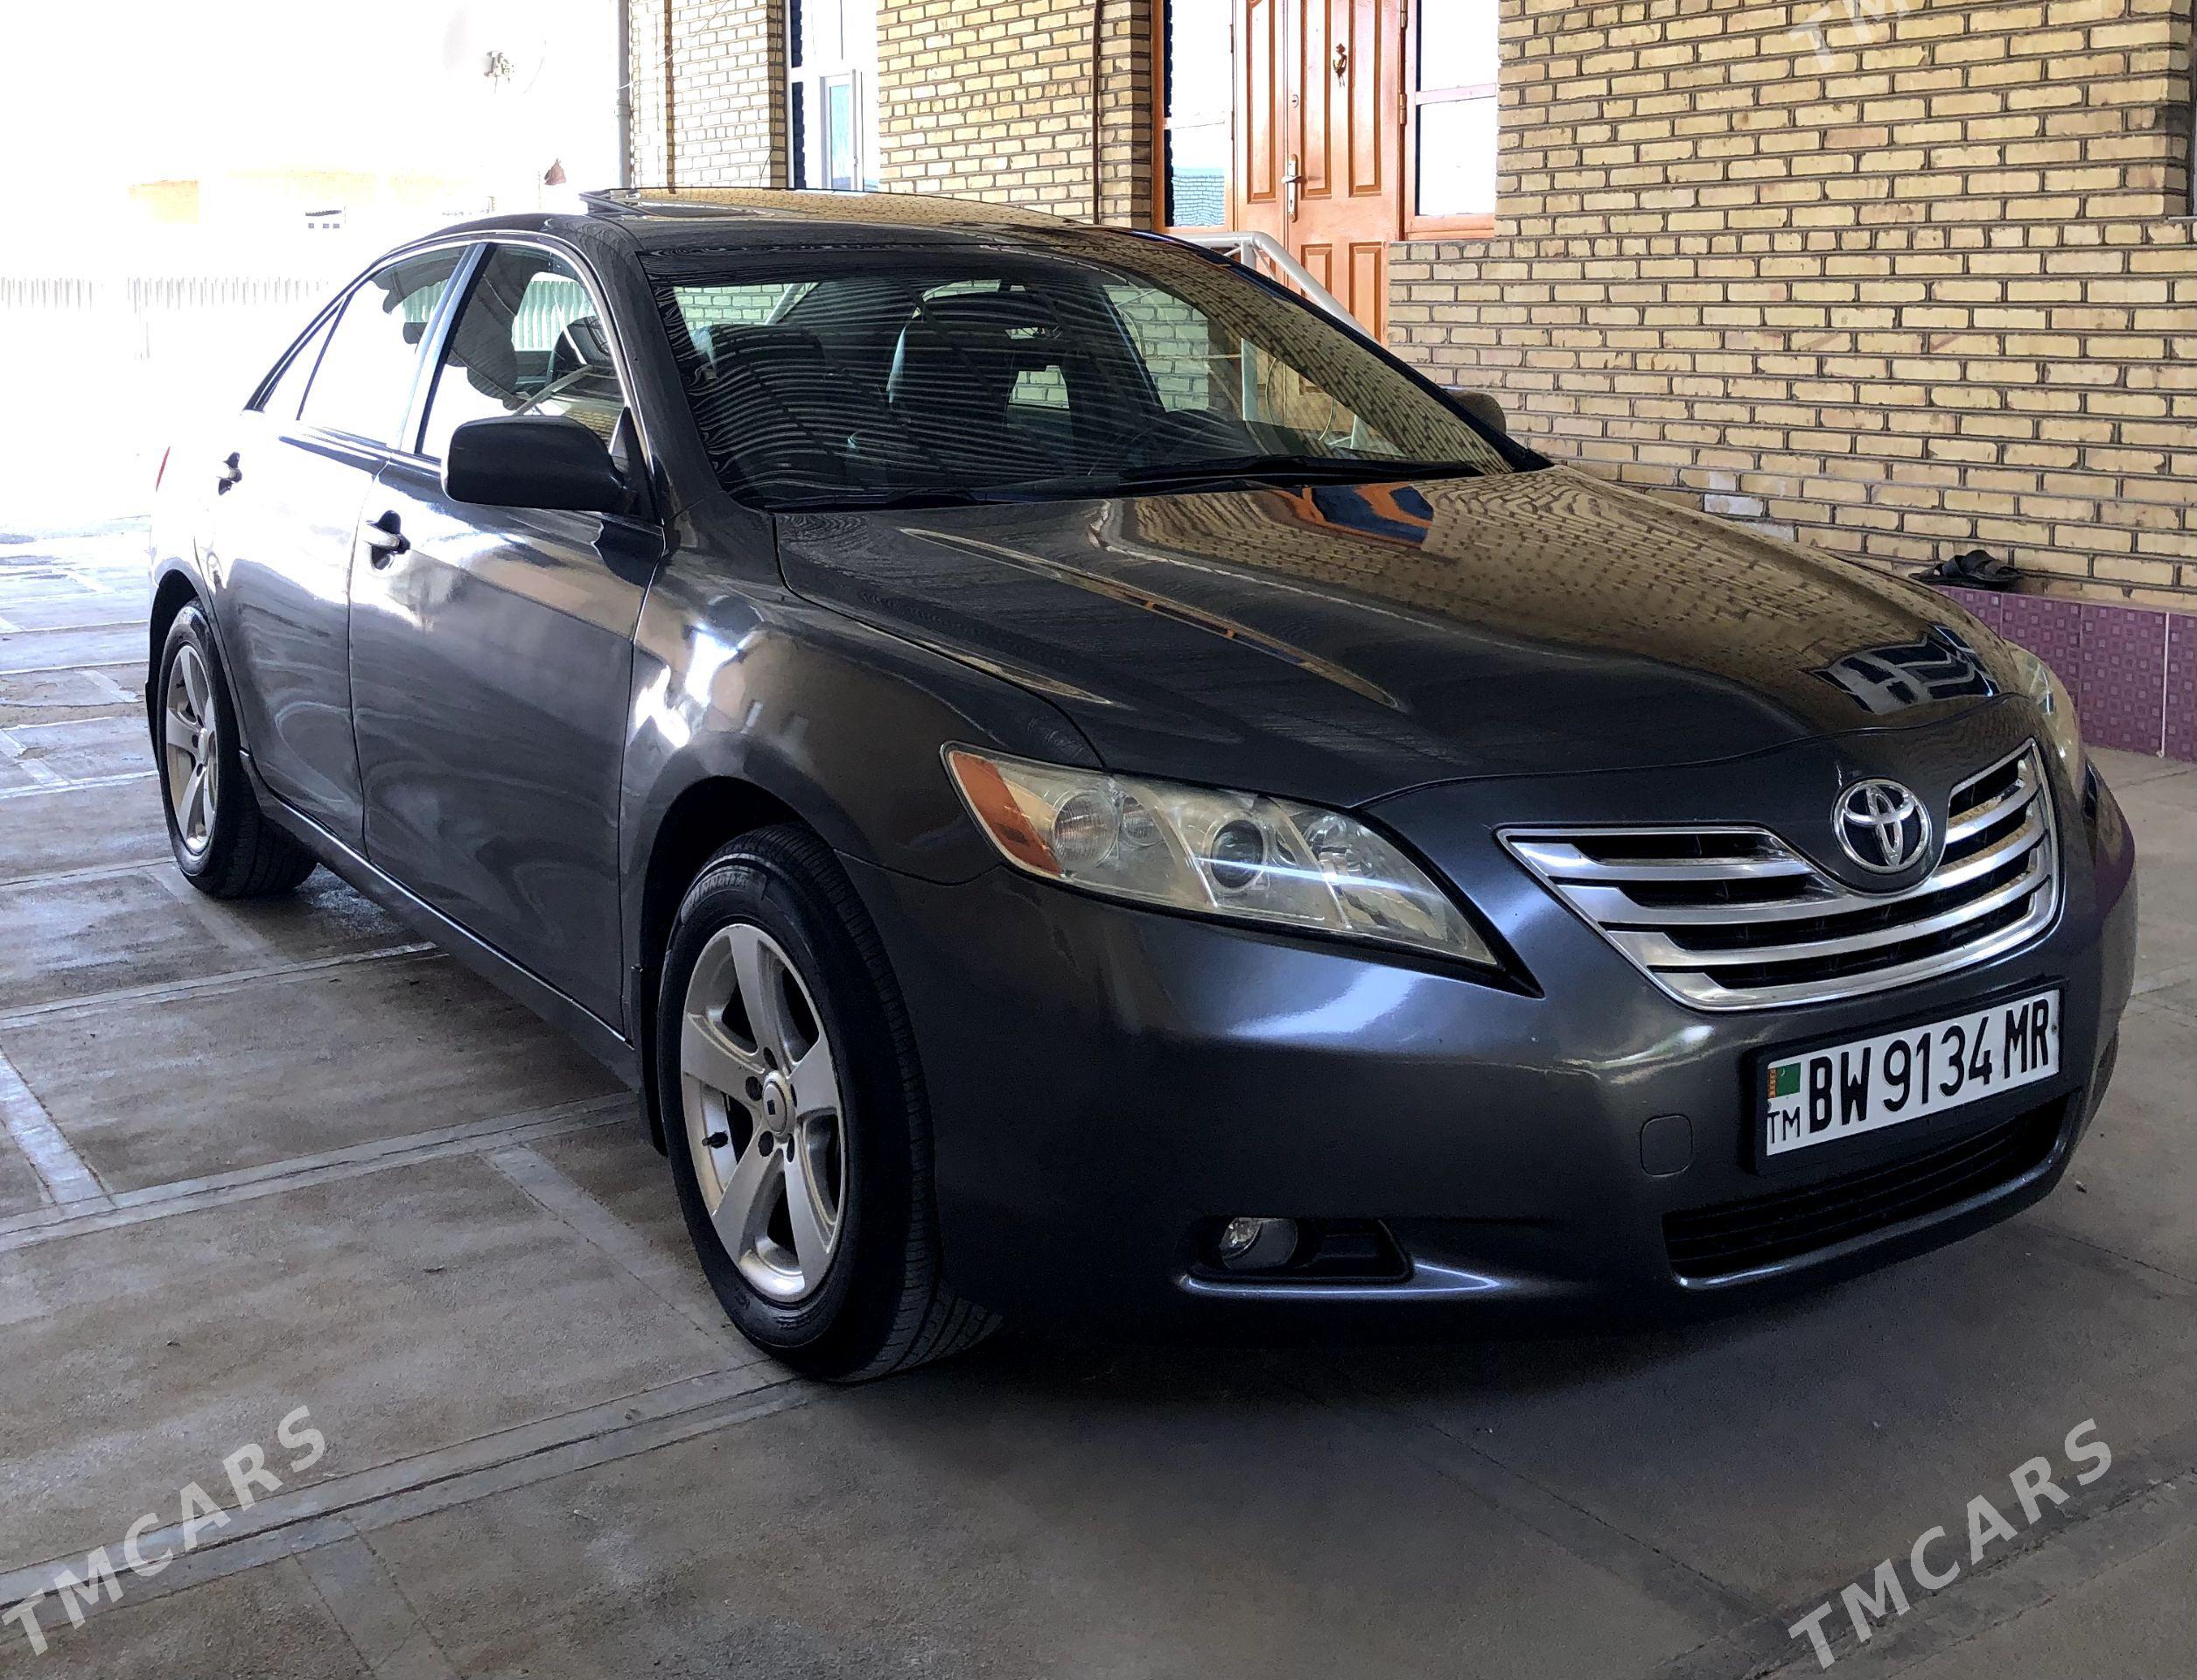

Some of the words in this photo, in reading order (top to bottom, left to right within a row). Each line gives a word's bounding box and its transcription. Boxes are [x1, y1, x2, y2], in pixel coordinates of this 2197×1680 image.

[1809, 1046, 1872, 1134] BW
[1882, 1016, 1993, 1112] 9134
[2003, 998, 2049, 1080] MR
[1767, 1106, 1801, 1144] TM
